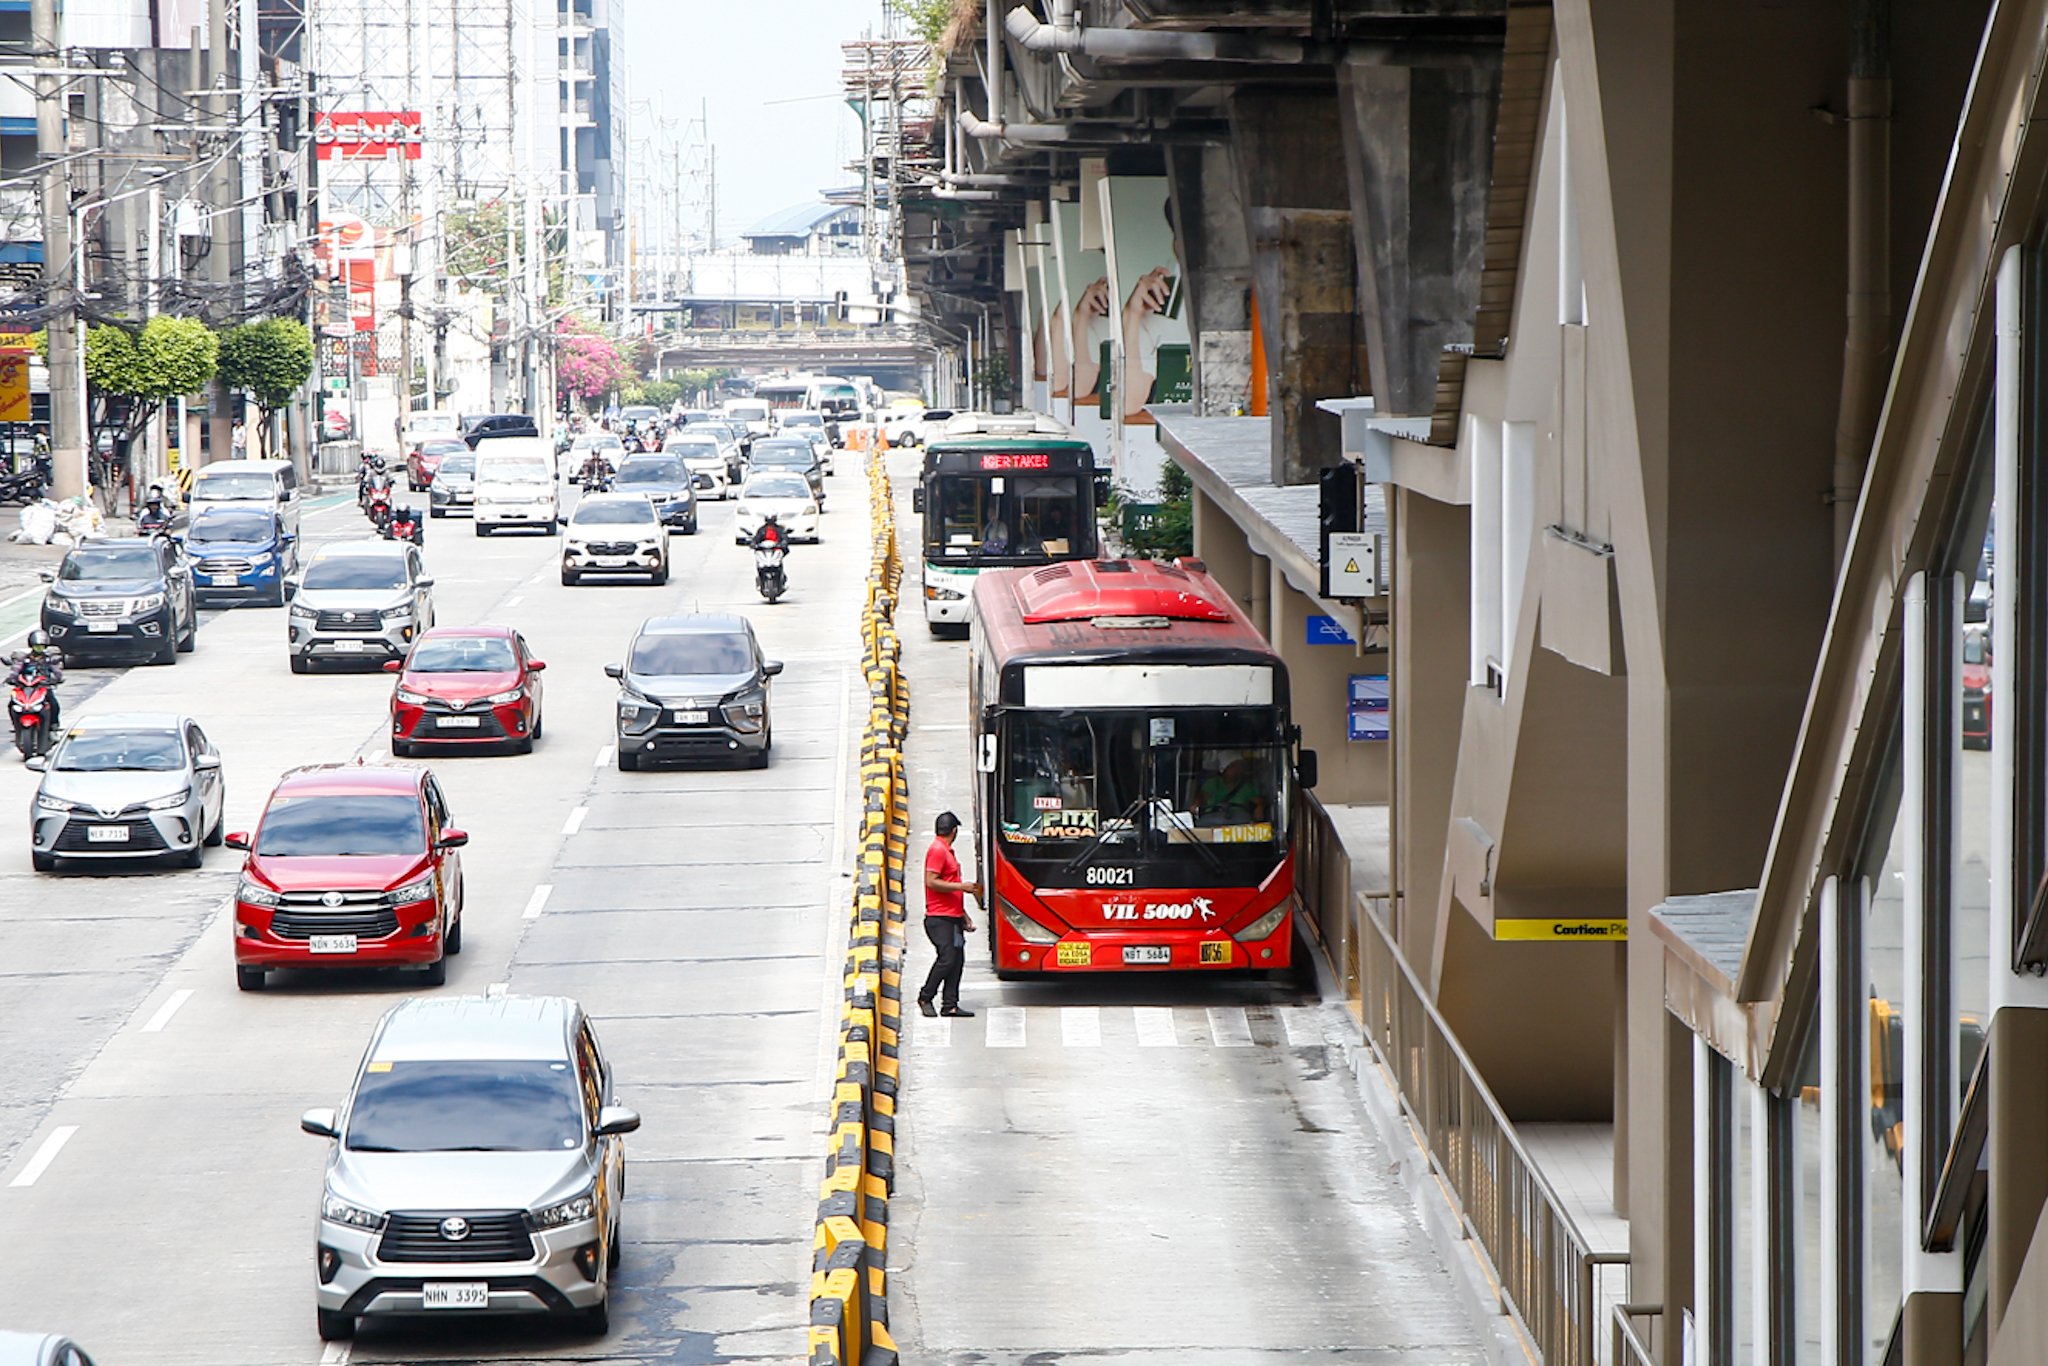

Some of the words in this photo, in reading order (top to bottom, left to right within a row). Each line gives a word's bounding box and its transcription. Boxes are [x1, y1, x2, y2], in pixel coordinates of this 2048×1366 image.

[1043, 810, 1096, 827] PITX
[1043, 826, 1096, 837] MOA
[1086, 868, 1134, 884] 80021
[1102, 904, 1139, 920] VIL
[1143, 904, 1194, 920] 5000
[1554, 924, 1608, 935] Caution:
[333, 940, 356, 949] 5634
[1124, 950, 1141, 959] NBT
[1146, 950, 1169, 959] 5684
[425, 1289, 448, 1303] NHN
[456, 1288, 487, 1303] 3395
